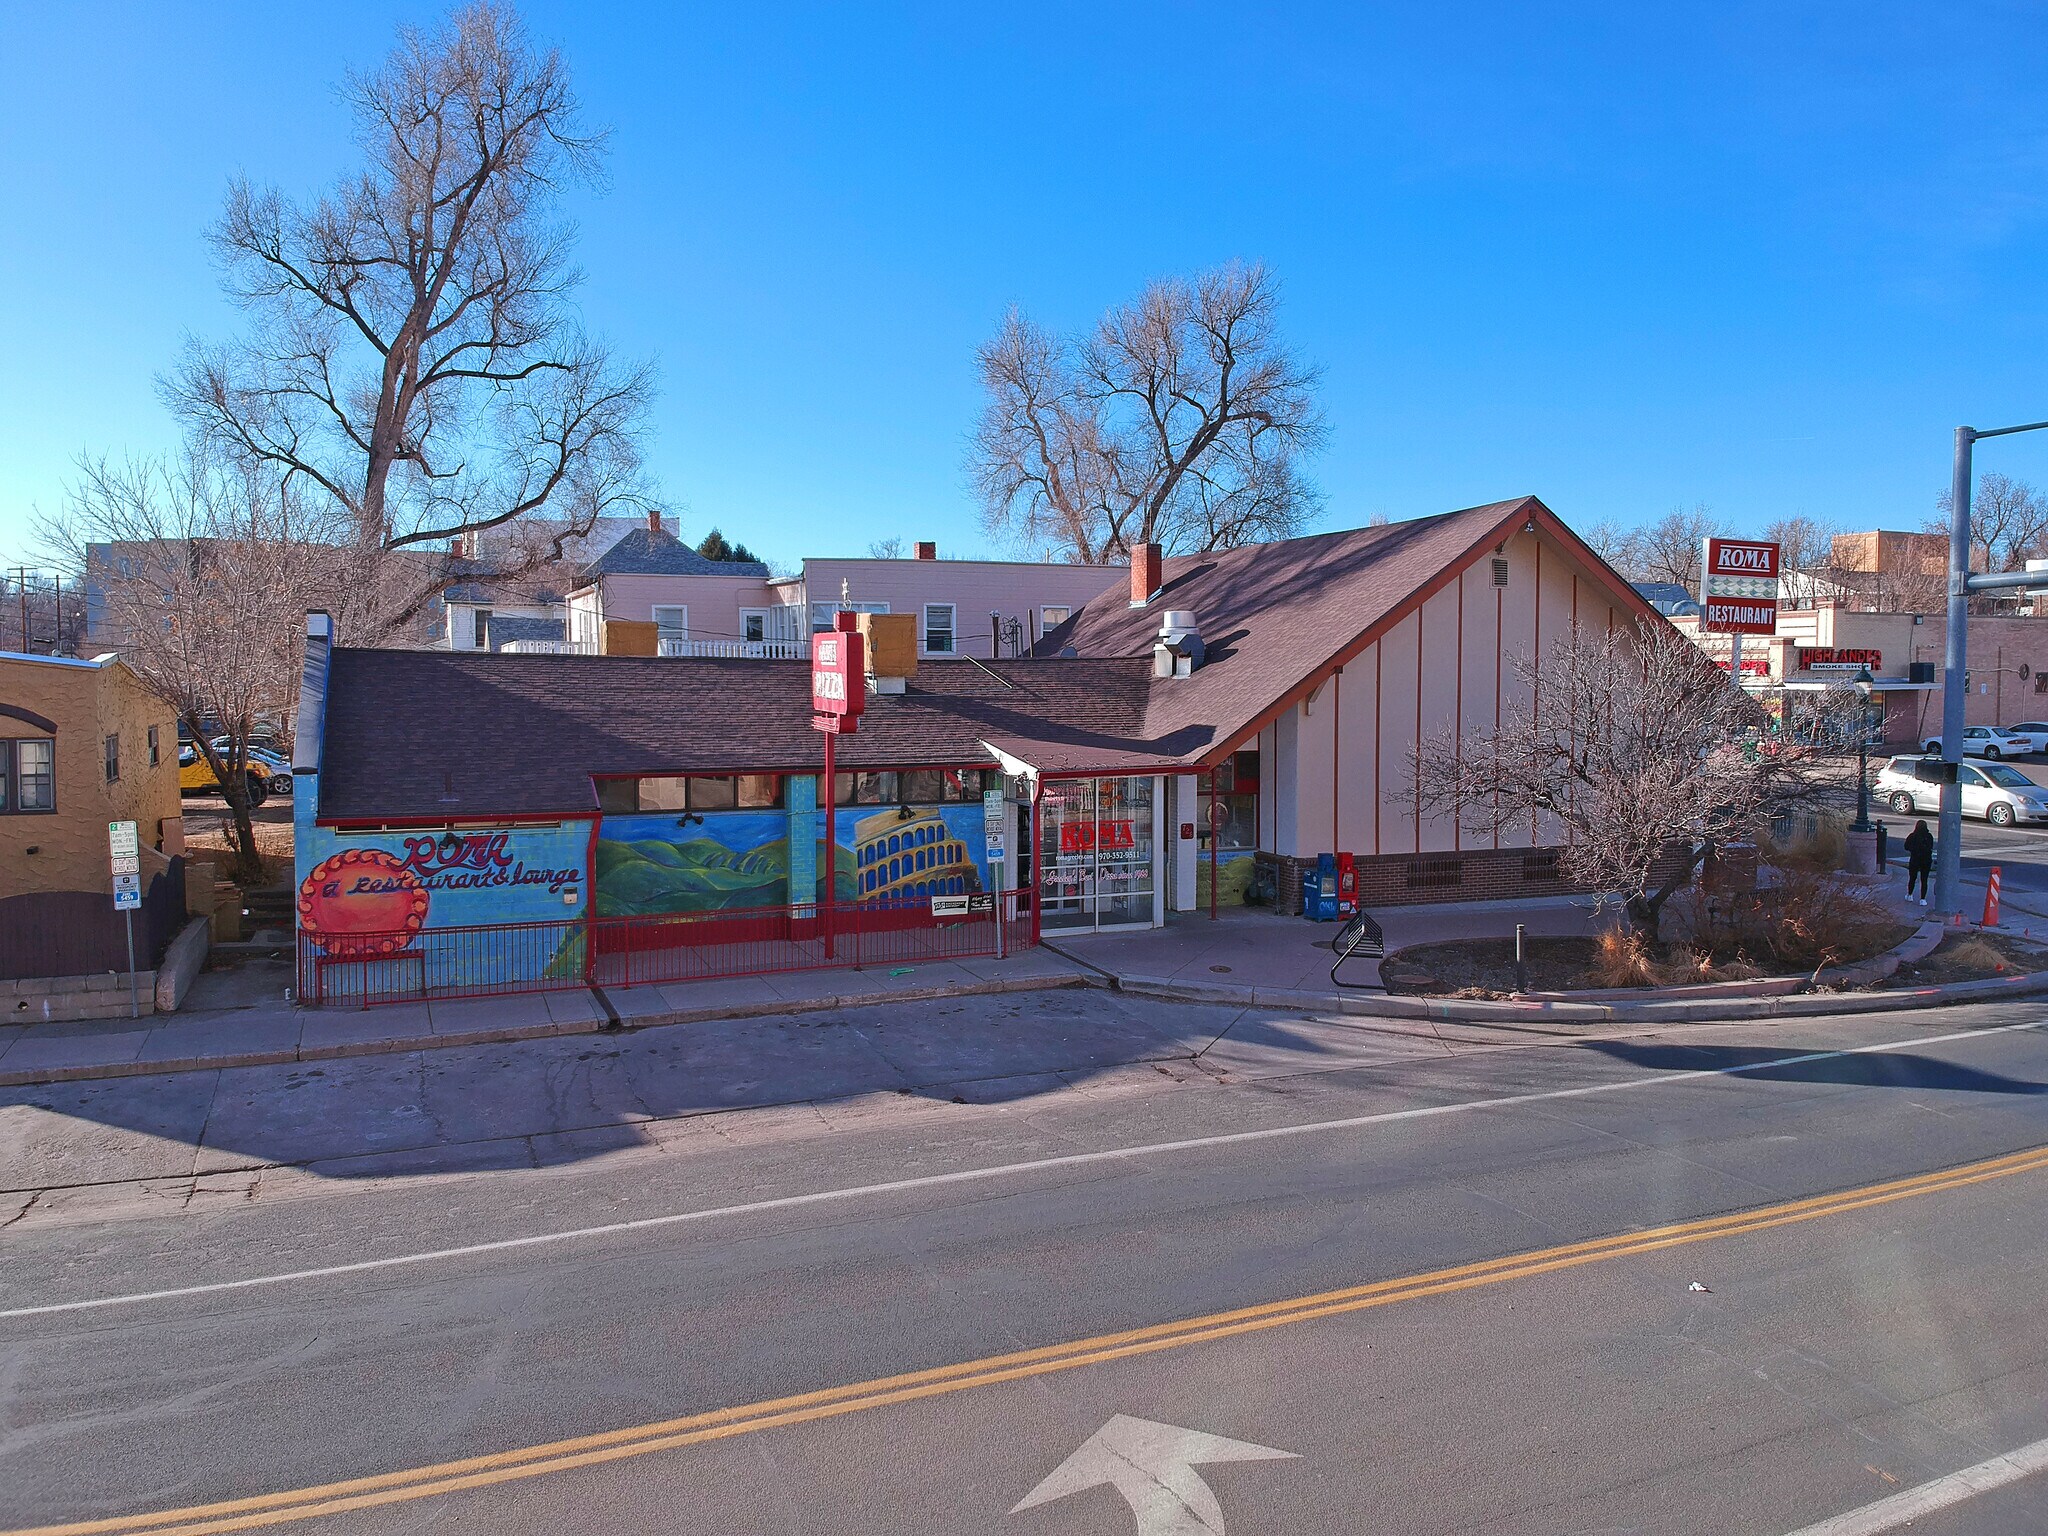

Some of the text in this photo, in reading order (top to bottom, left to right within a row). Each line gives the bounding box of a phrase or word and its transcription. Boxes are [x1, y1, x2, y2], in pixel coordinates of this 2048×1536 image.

[1717, 549, 1770, 568] ROMA
[1708, 604, 1775, 625] RESTAURANT
[1800, 648, 1882, 671] HIGHLANDER
[1060, 823, 1135, 849] ROMA
